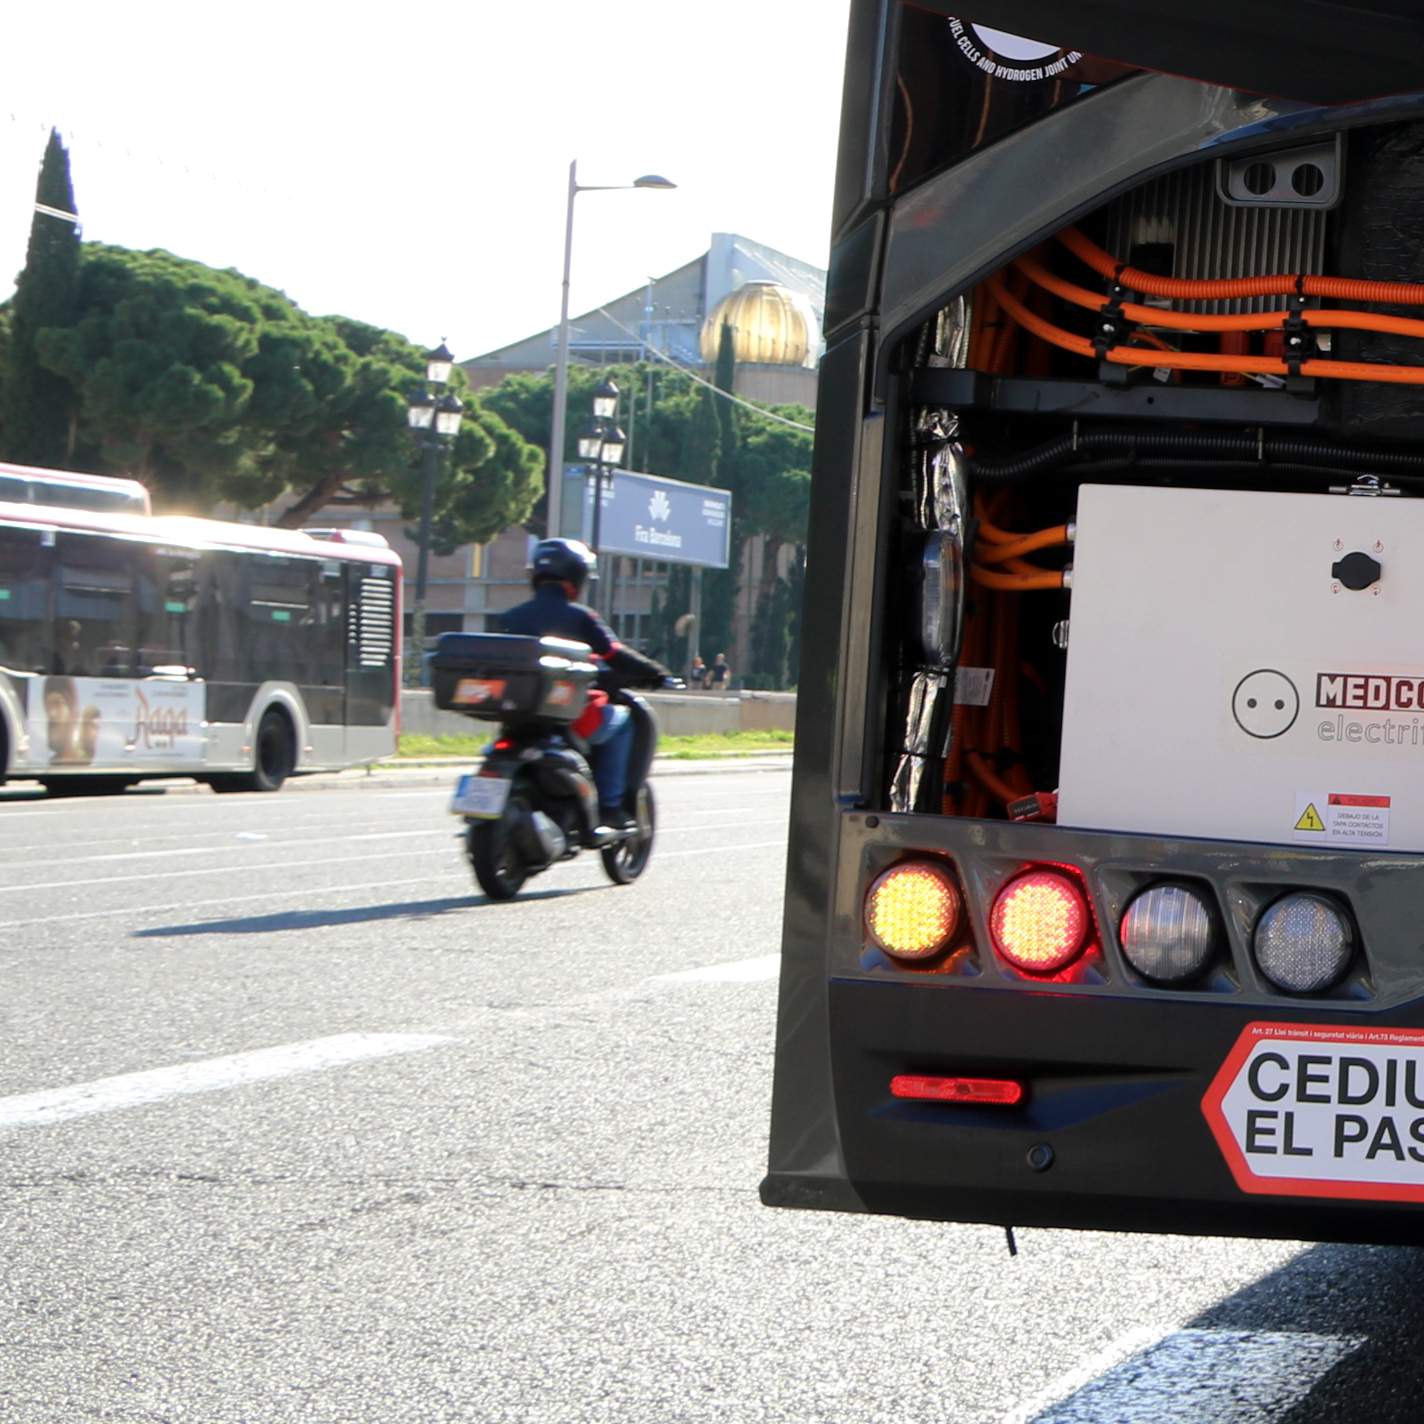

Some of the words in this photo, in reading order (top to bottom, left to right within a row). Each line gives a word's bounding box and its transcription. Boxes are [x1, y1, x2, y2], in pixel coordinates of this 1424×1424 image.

[957, 36, 981, 62] CELLS
[976, 56, 996, 74] AND
[994, 65, 1043, 81] HYDROGEN
[1045, 57, 1069, 78] JOINT
[1245, 1110, 1313, 1156] EL
